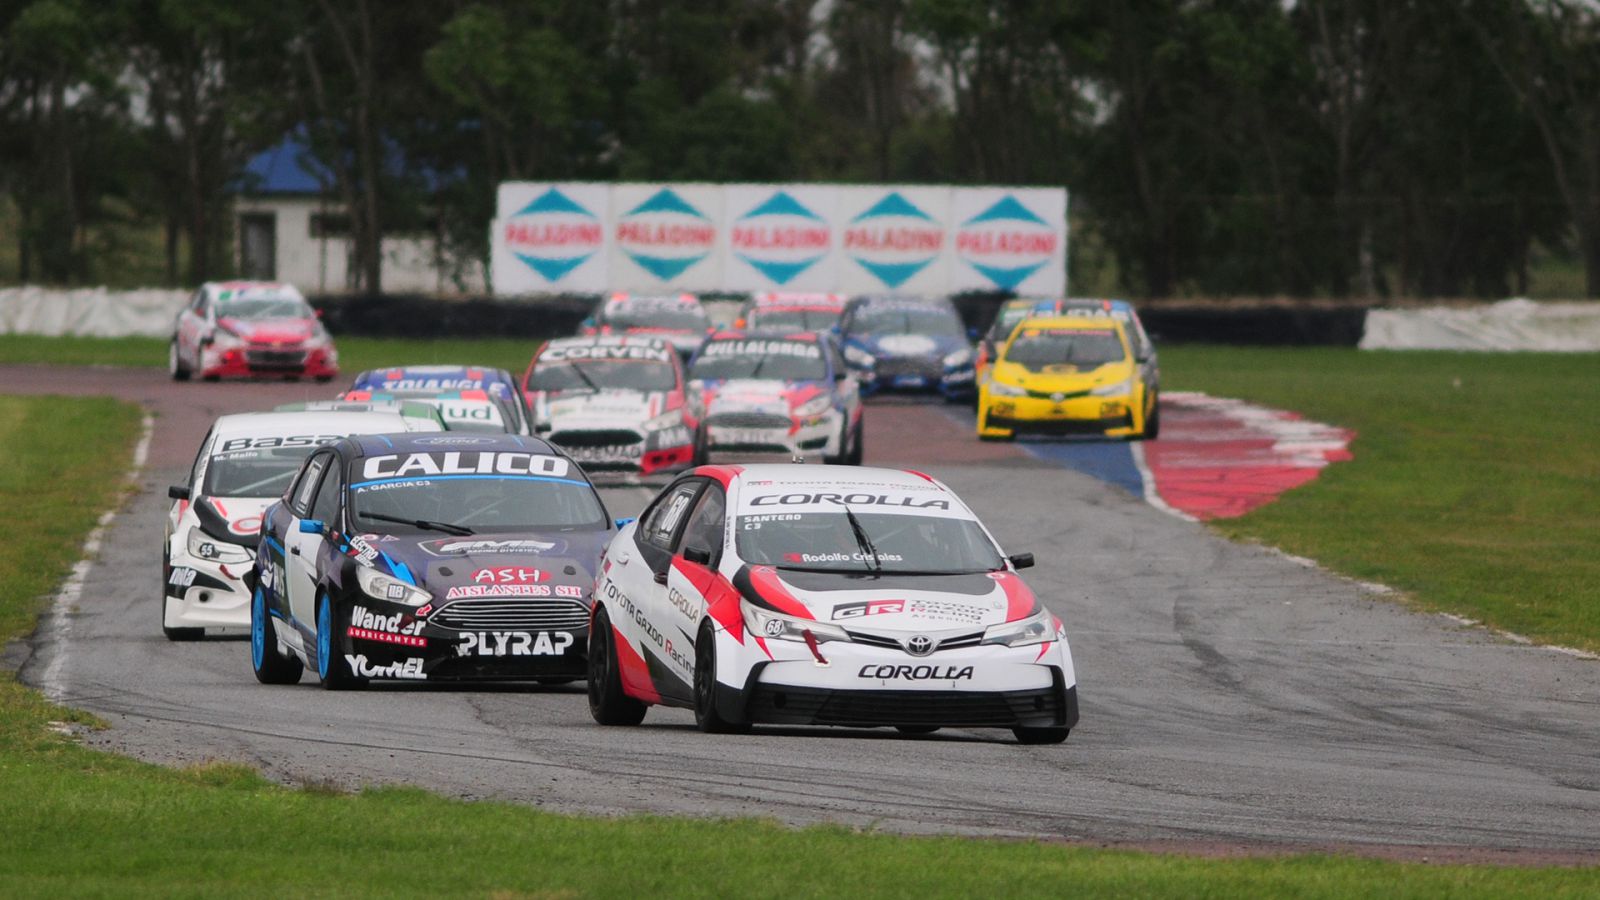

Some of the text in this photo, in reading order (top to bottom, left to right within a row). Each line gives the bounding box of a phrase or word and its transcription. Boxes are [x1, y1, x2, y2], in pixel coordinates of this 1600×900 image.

[363, 451, 569, 479] CALICO
[370, 481, 413, 491] GARCIA
[750, 493, 950, 510] COROLLA
[744, 514, 802, 523] SANTERO
[744, 523, 761, 531] C3
[201, 545, 213, 556] 55
[350, 535, 379, 560] ELECTRO
[802, 553, 903, 562] Rodolfo Crisales
[475, 569, 540, 583] ASH
[447, 584, 582, 599] AISLANTES SH
[604, 578, 635, 619] TOYOTA
[635, 611, 663, 648] GAZOO
[668, 587, 699, 624] COROLLA
[832, 602, 905, 620] GR
[352, 605, 427, 636] Wander
[910, 607, 982, 621] Racing
[766, 619, 781, 634] 68
[349, 629, 425, 646] LUBRICANTES
[459, 631, 574, 656] PLYRAP
[858, 664, 974, 680] COROLLA
